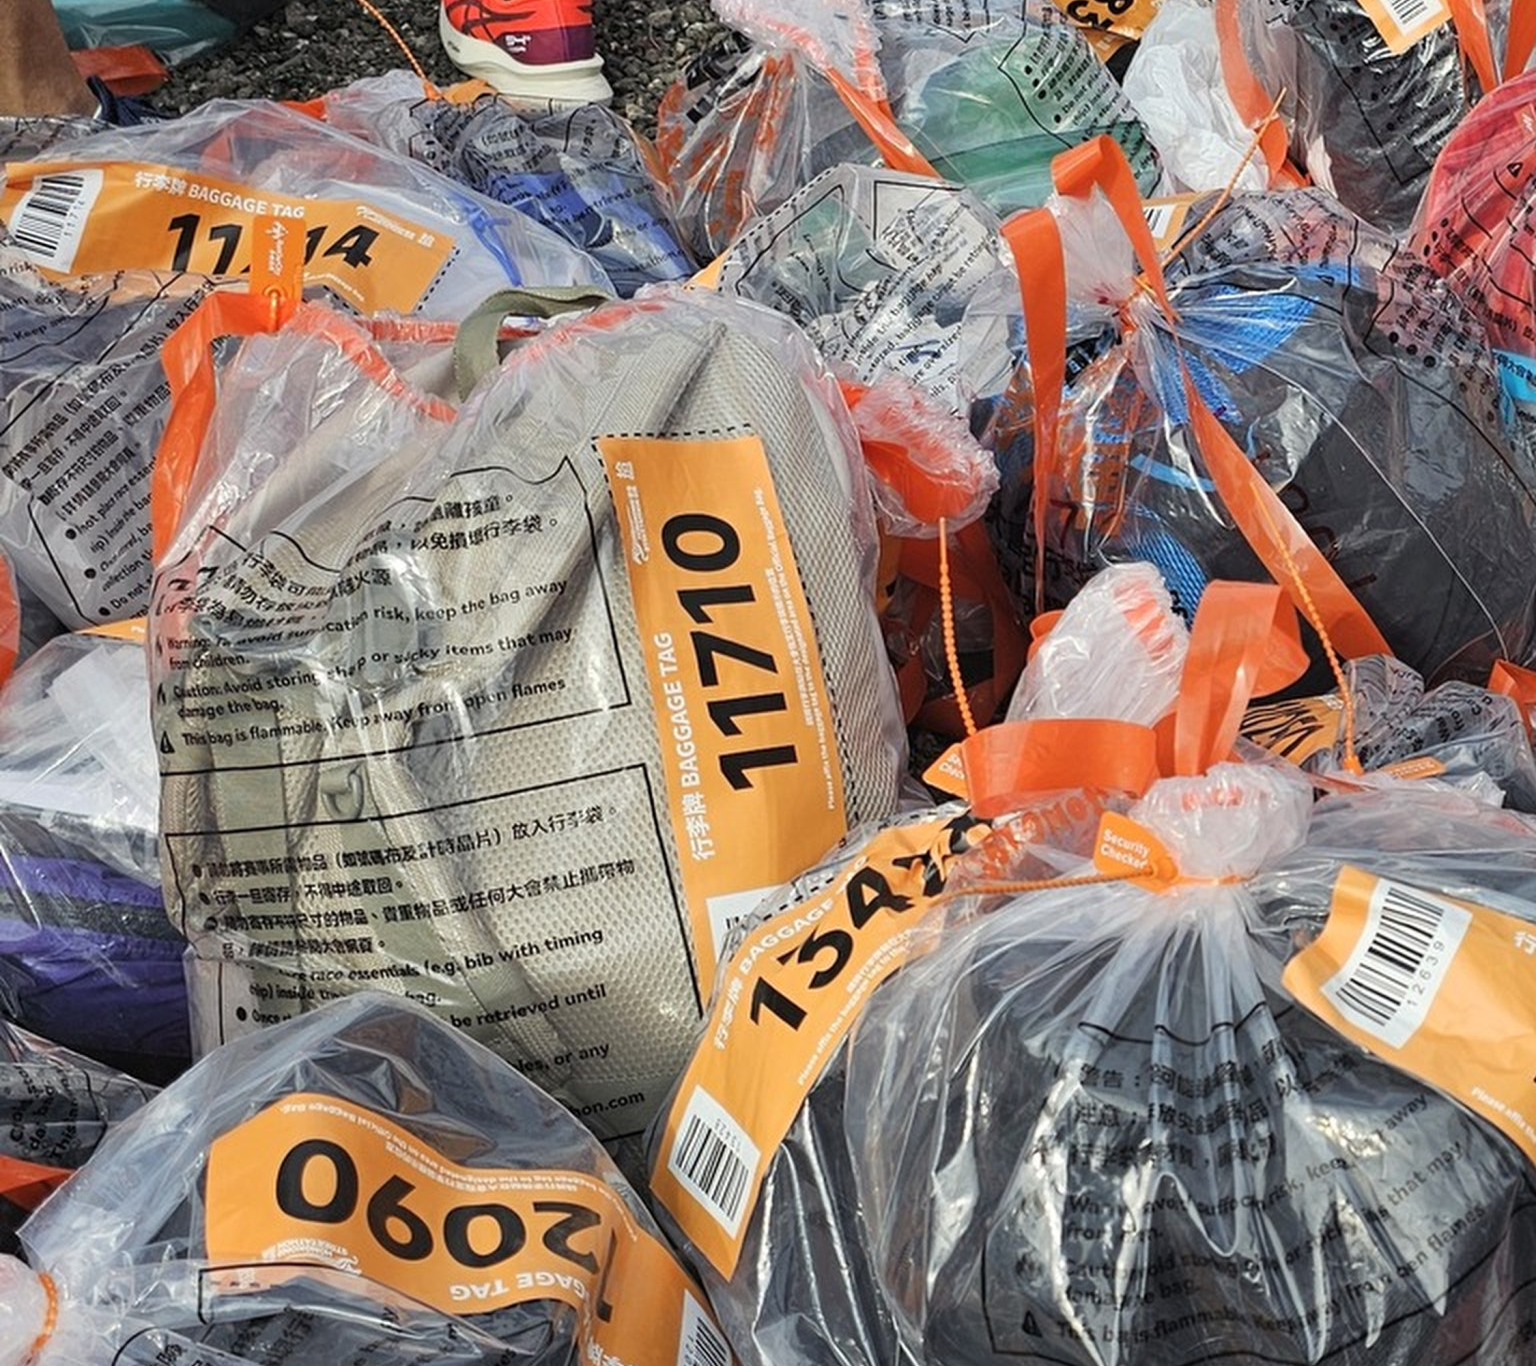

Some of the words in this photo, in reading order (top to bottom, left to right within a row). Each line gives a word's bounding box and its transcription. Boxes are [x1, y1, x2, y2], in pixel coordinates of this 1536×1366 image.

[134, 171, 186, 198] 行李牌
[187, 184, 268, 216] BAGGAGE
[270, 202, 305, 218] TAG
[167, 214, 381, 275] 1114
[488, 588, 522, 608] bag
[525, 579, 569, 600] away
[445, 642, 494, 659] items
[498, 634, 535, 652] that
[654, 631, 684, 680] TAG
[660, 512, 799, 792] 11710
[510, 679, 567, 703] flames
[662, 680, 703, 789] BAGGAGE
[681, 792, 716, 862] 行李牌
[1102, 826, 1151, 860] Security
[465, 953, 495, 973] bib
[496, 942, 542, 964] with
[544, 929, 604, 955] timing
[740, 900, 835, 976] BAGGAGE
[1407, 940, 1445, 1008] 12639
[450, 1014, 473, 1029] be
[564, 984, 607, 1006] until
[554, 1053, 575, 1067] or
[577, 1042, 610, 1064] any
[274, 1138, 619, 1322] 12090
[449, 1275, 511, 1302] TAG
